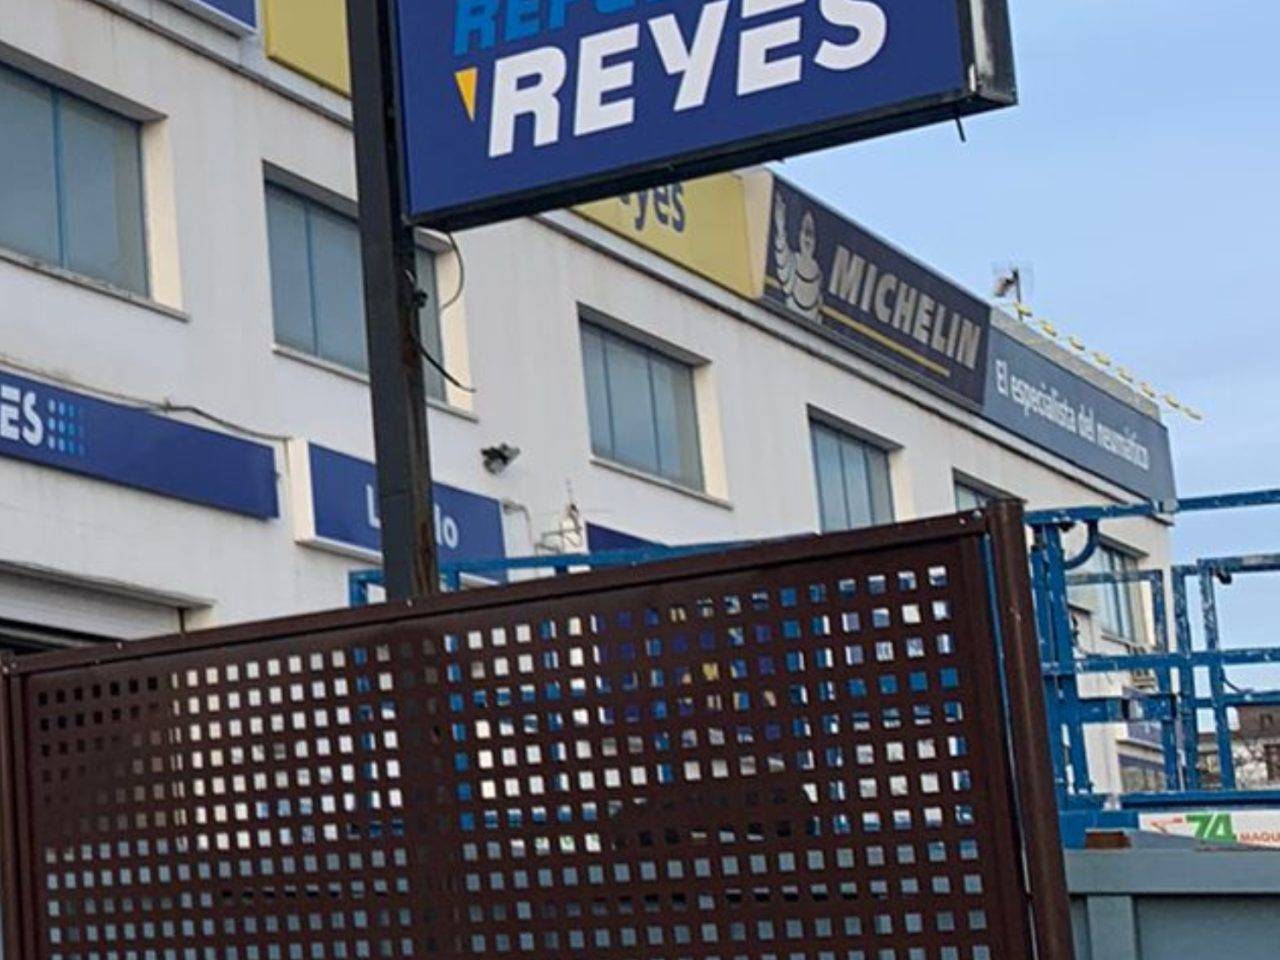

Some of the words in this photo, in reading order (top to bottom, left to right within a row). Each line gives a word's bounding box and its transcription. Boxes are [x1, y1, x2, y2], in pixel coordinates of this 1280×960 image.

[620, 182, 686, 232] yes
[828, 244, 981, 371] MICHELIN
[995, 358, 1009, 398] El
[1077, 403, 1097, 444] del
